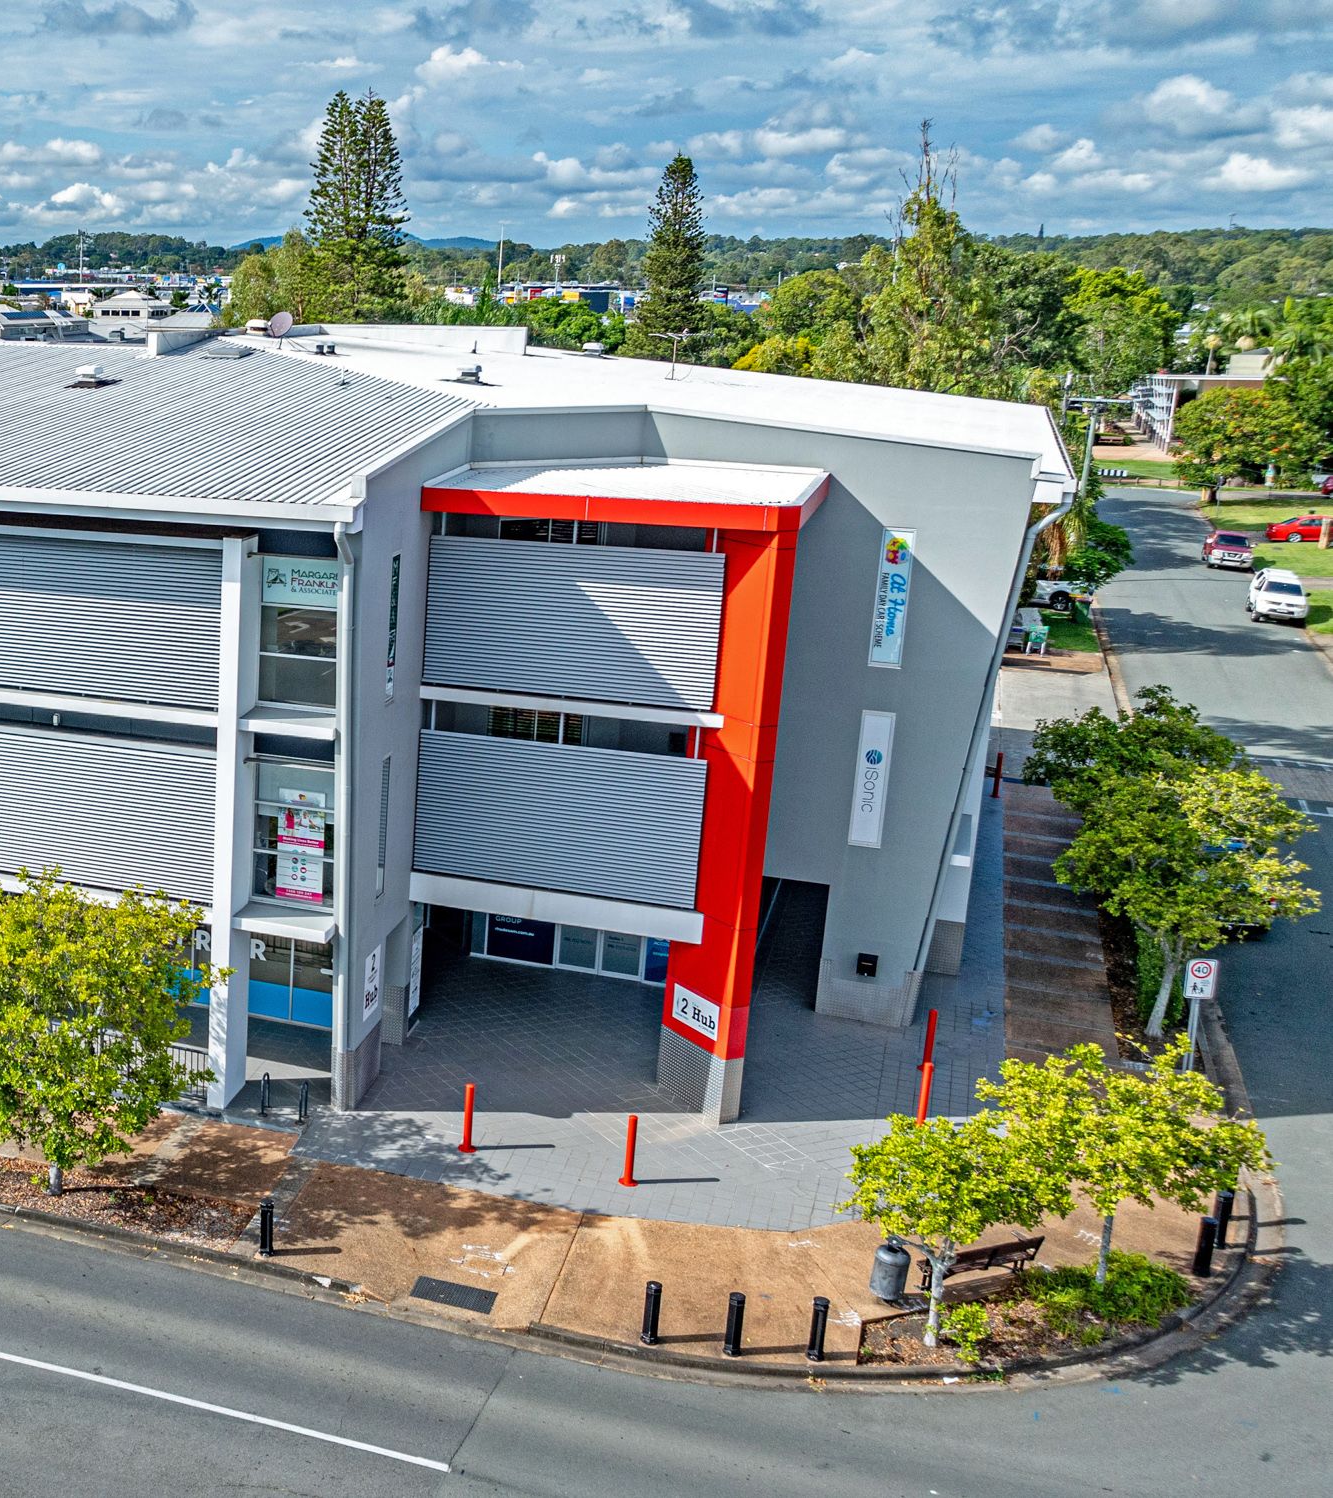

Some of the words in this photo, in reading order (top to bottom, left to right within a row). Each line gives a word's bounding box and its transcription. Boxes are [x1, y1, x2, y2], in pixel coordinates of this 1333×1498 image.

[879, 572, 890, 595] FAMILY
[885, 598, 906, 637] Home
[873, 623, 884, 648] SCHEME
[495, 915, 523, 925] GROUP
[1194, 966, 1209, 975] 40
[680, 997, 689, 1015] 2
[691, 1006, 716, 1031] Hub
